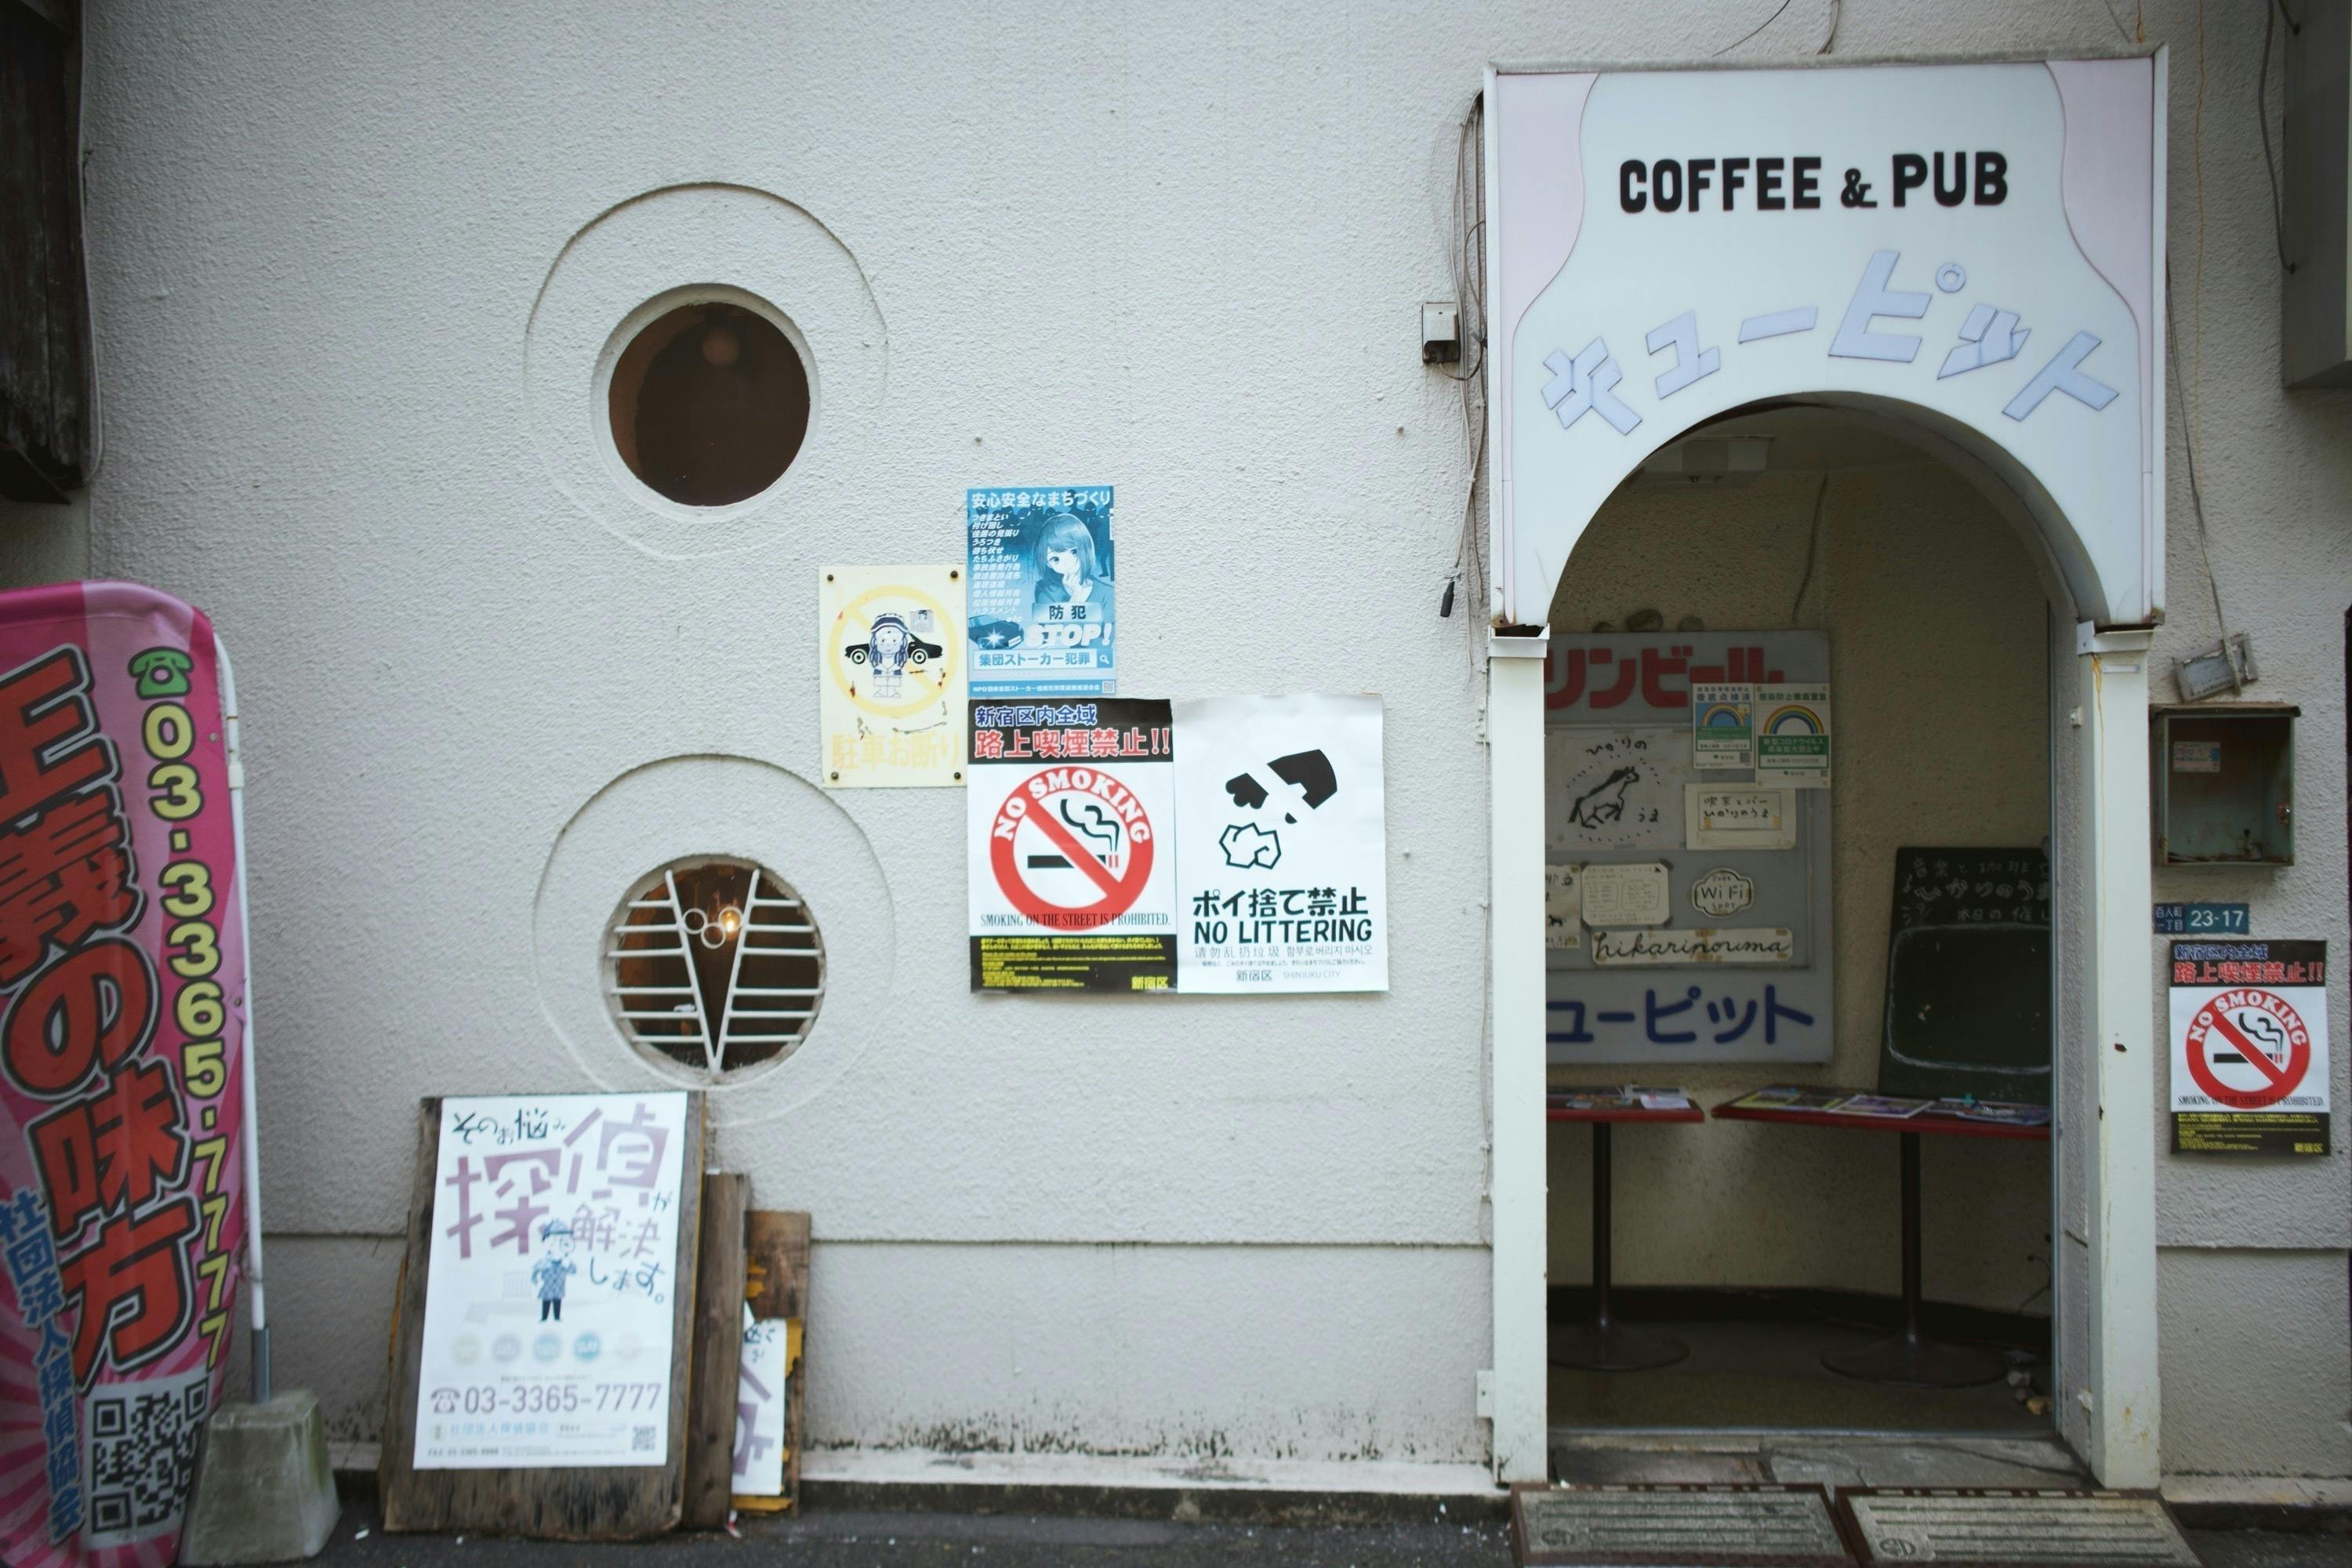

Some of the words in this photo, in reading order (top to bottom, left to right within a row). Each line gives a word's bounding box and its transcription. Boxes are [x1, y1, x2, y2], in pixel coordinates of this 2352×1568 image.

[1620, 156, 1822, 213] COFFEE
[1841, 167, 1878, 209] &
[1891, 151, 2009, 208] PUB
[971, 491, 1111, 509] 安心安全なまちづくり
[972, 554, 1019, 563] たちふさがり
[1049, 605, 1086, 619] 防犯
[979, 652, 1091, 666] 集団ストーカー犯罪
[975, 704, 1098, 726] 新宿区内全域
[831, 732, 960, 771] 駐車お断り
[975, 727, 1171, 760] 路上喫煙禁止!!
[995, 797, 1027, 841] NO
[1028, 768, 1150, 844] SMOKING
[1192, 887, 1368, 917] ポイ捨て禁止
[980, 913, 1024, 927] SMOKING
[1025, 913, 1040, 927] ON
[1041, 913, 1060, 927] THE
[1062, 913, 1099, 927] STREET
[1100, 913, 1110, 926] IS
[1111, 913, 1171, 927] PROHIBITED.
[2190, 909, 2244, 927] 23-17
[1194, 921, 1228, 945] NO
[1239, 918, 1373, 944] LITTERING
[1195, 946, 1280, 959] 请勿乱扔垃圾
[1344, 944, 1374, 956] 마시오
[1131, 975, 1169, 991] 新宿区
[1236, 969, 1272, 982] 新宿区
[1283, 971, 1321, 979] SHINJUKU
[2189, 1011, 2214, 1044] NO
[2214, 989, 2307, 1046] SMOKING
[445, 1102, 670, 1260] 探偵
[569, 1203, 661, 1258] 解決
[589, 1256, 665, 1305] します。
[463, 1382, 662, 1414] 03-3365-7777
